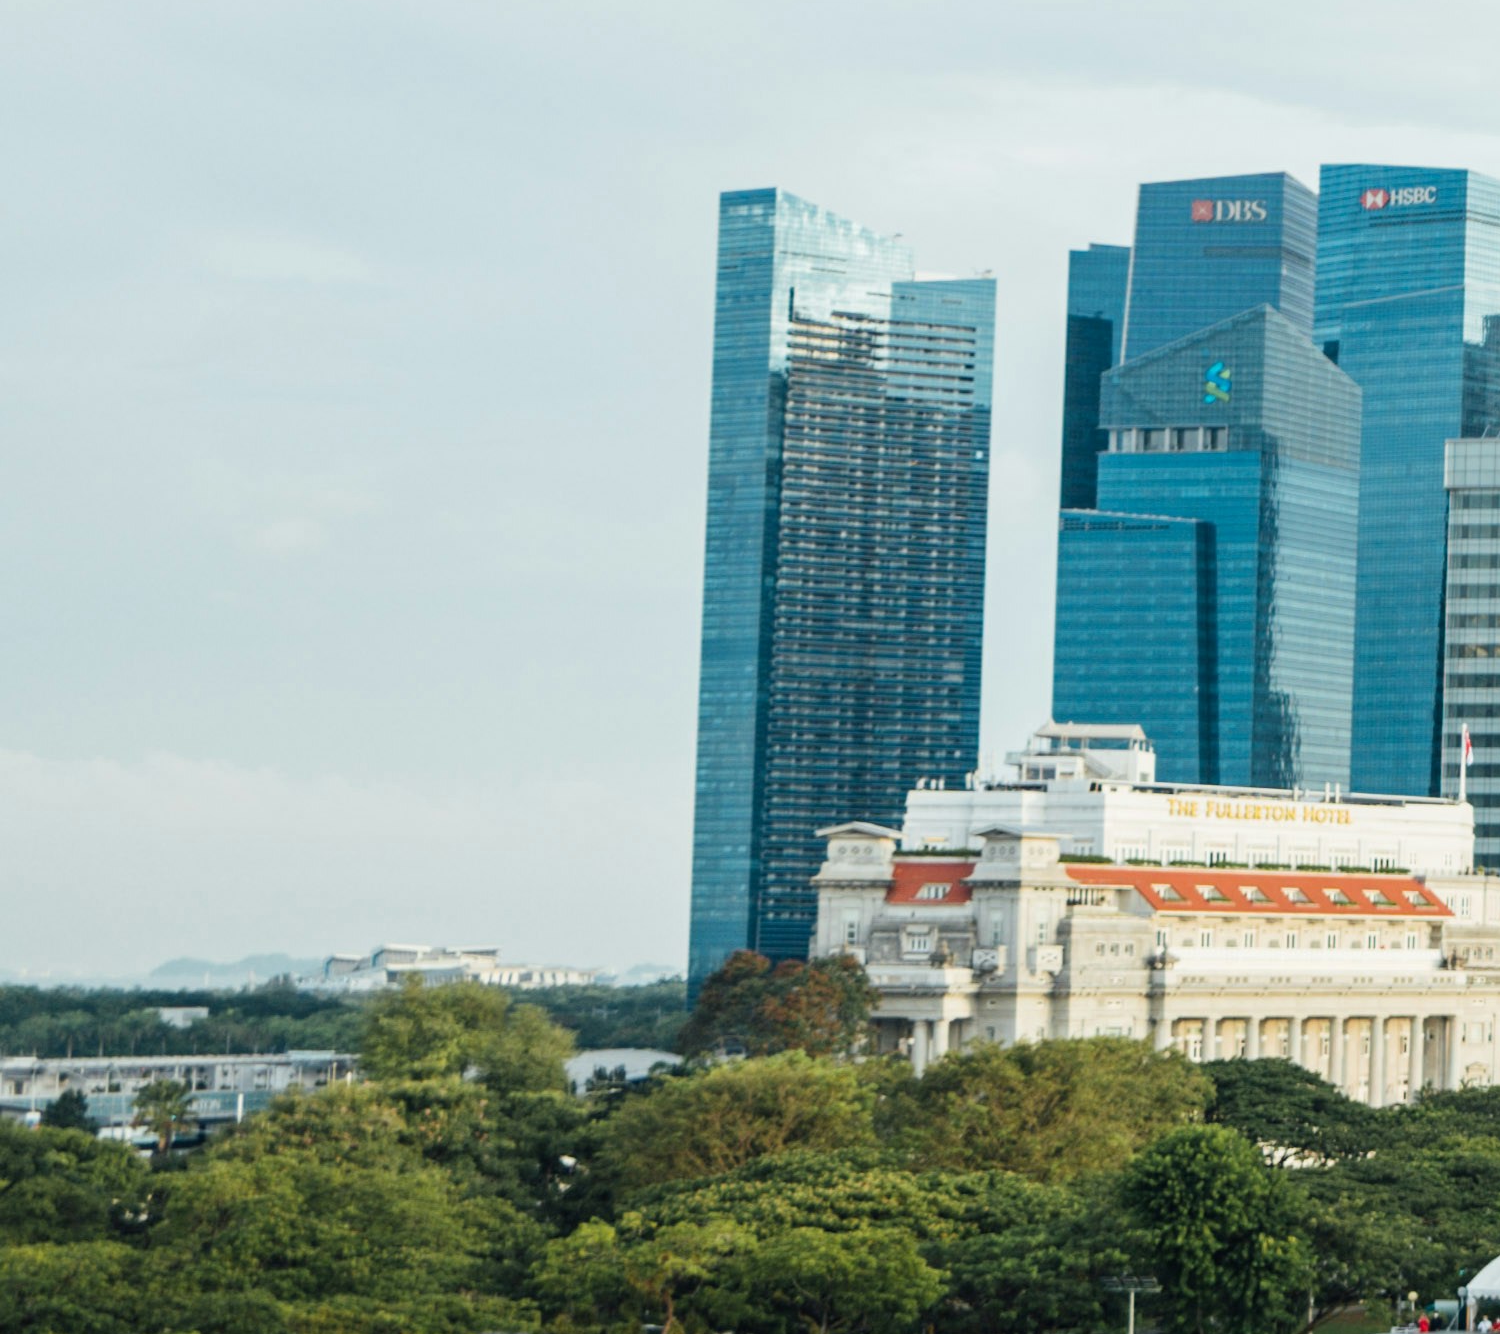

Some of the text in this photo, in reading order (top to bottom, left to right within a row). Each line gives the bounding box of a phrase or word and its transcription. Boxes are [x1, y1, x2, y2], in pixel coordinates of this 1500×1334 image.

[1390, 187, 1436, 206] HSBC
[1214, 200, 1267, 221] DBS
[1167, 798, 1351, 825] THE FULLERTON HOTEL
